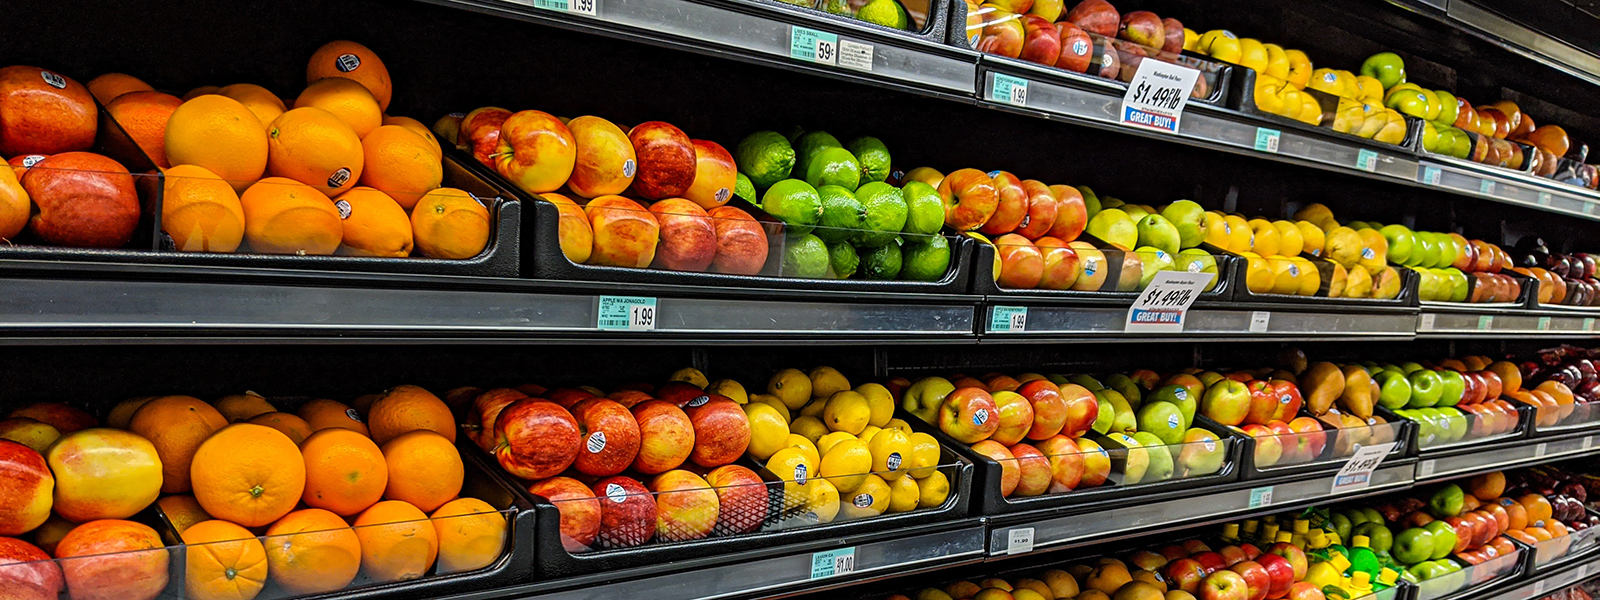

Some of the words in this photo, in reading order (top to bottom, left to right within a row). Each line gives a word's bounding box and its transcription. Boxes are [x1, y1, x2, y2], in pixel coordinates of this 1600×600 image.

[573, 0, 593, 12] 1.99
[1012, 87, 1025, 104] 1.99
[1133, 80, 1170, 107] $1.49
[1130, 110, 1153, 125] GREAT
[1154, 116, 1172, 129] BUY!
[1142, 288, 1179, 306] $1.49
[634, 307, 653, 326] 1.99
[1012, 315, 1024, 329] 1.99
[1136, 311, 1159, 322] GREAT
[1160, 312, 1177, 322] BUY!
